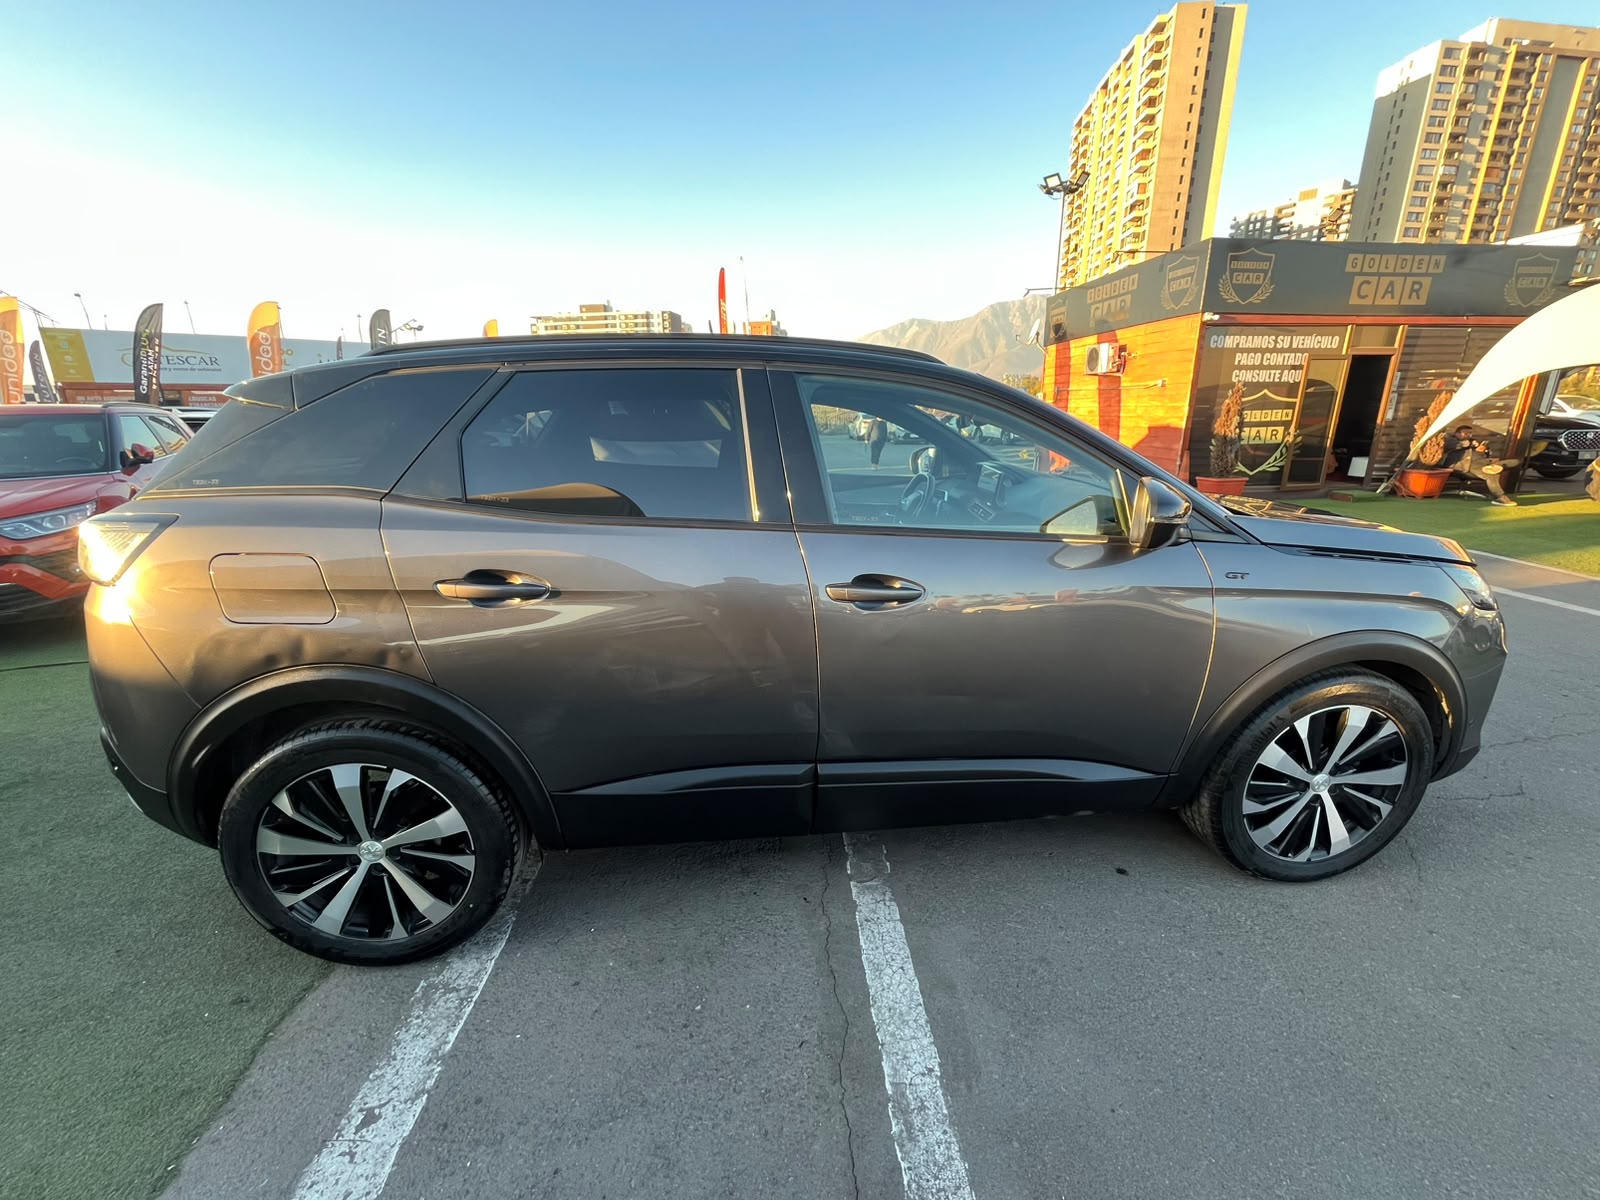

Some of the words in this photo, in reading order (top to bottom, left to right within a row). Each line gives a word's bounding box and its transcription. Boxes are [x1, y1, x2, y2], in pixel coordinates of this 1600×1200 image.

[1349, 256, 1443, 271] GOLDEN
[1233, 273, 1264, 284] CAR
[1353, 278, 1428, 302] CAR
[1210, 335, 1275, 349] COMPRAMOS
[1276, 335, 1290, 349] SU
[1292, 334, 1340, 349] VEHÍCULO
[255, 331, 272, 374] idad
[1234, 353, 1261, 366] PAGO
[1262, 352, 1309, 366] CONTADO
[1232, 370, 1281, 382] CONSULTE
[1281, 370, 1303, 383] AQU
[1243, 410, 1291, 420] OLDEN
[1241, 428, 1281, 442] AR
[1225, 571, 1250, 580] GT
